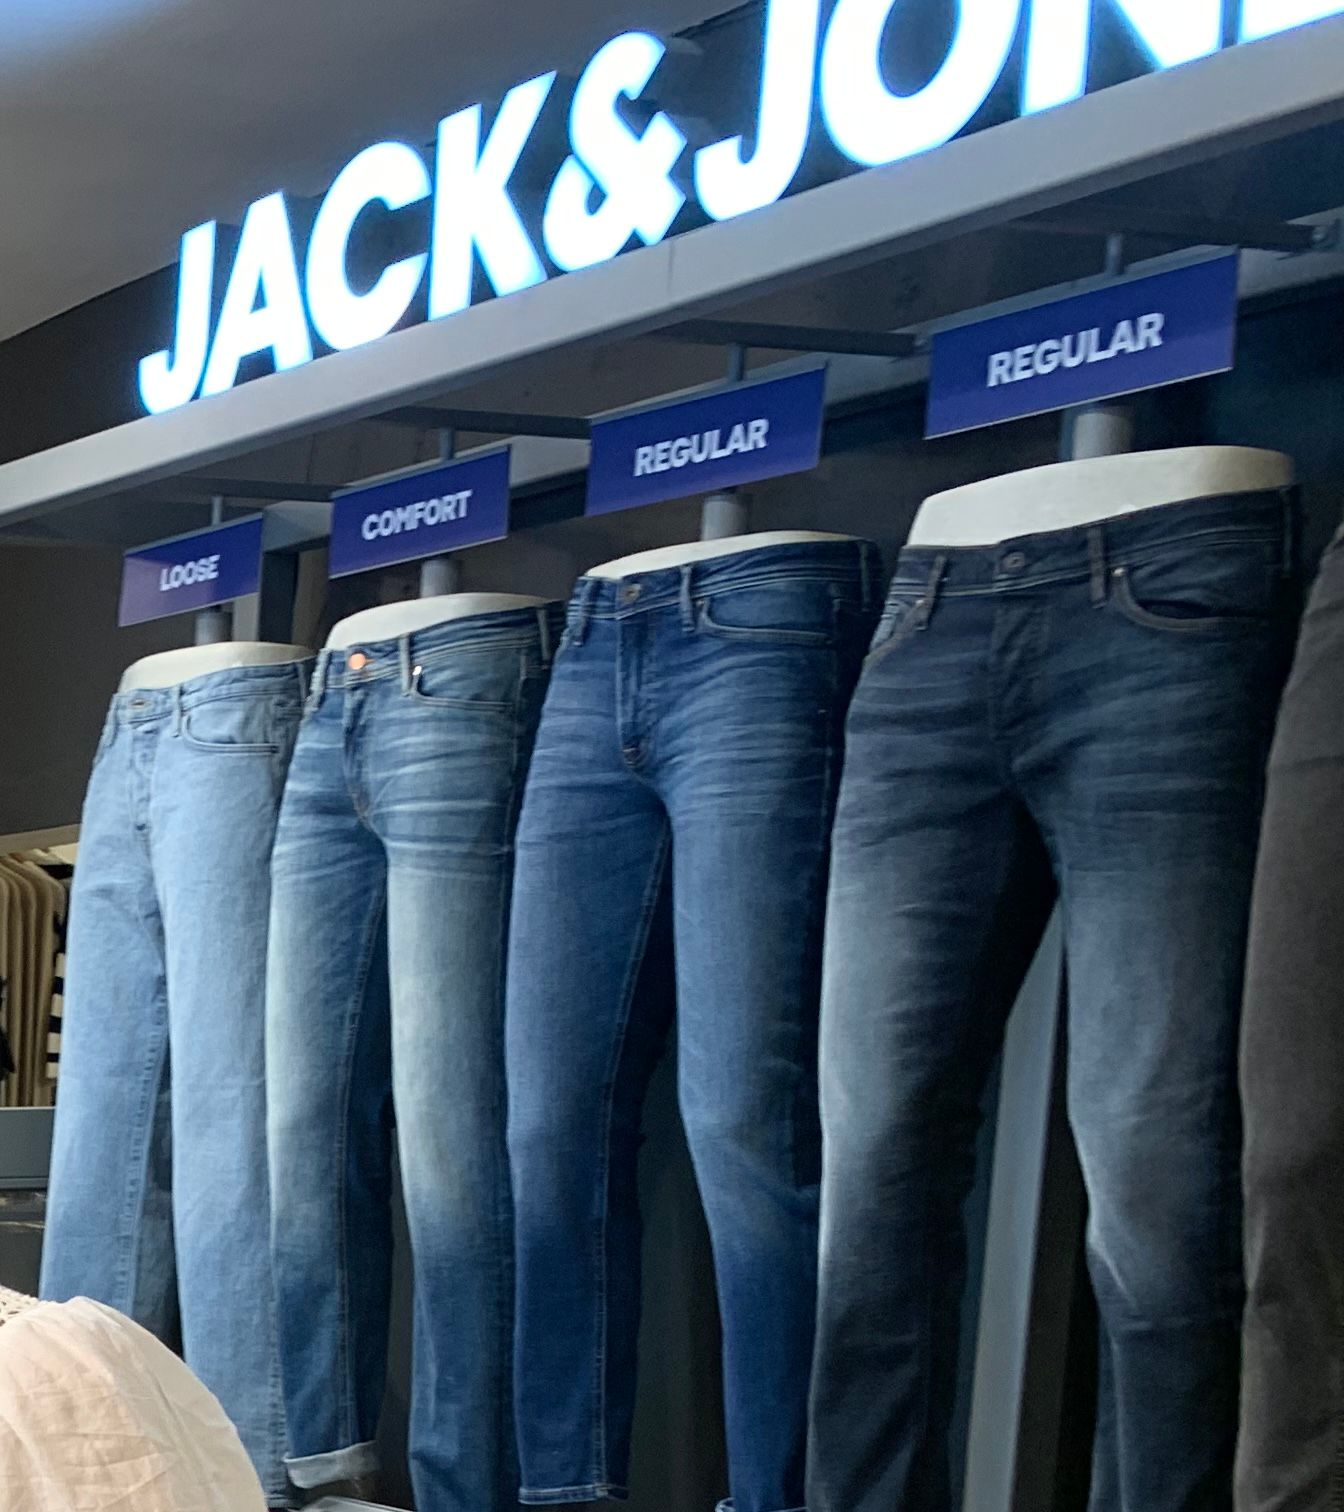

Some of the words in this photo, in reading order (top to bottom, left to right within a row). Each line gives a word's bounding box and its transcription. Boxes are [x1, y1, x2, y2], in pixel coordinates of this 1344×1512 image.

[138, 0, 1344, 416] JACK&JO
[985, 312, 1166, 388] REGULAR
[633, 418, 770, 478] REGULAR
[361, 489, 473, 541] COMFORT
[159, 554, 221, 592] LOOSE
